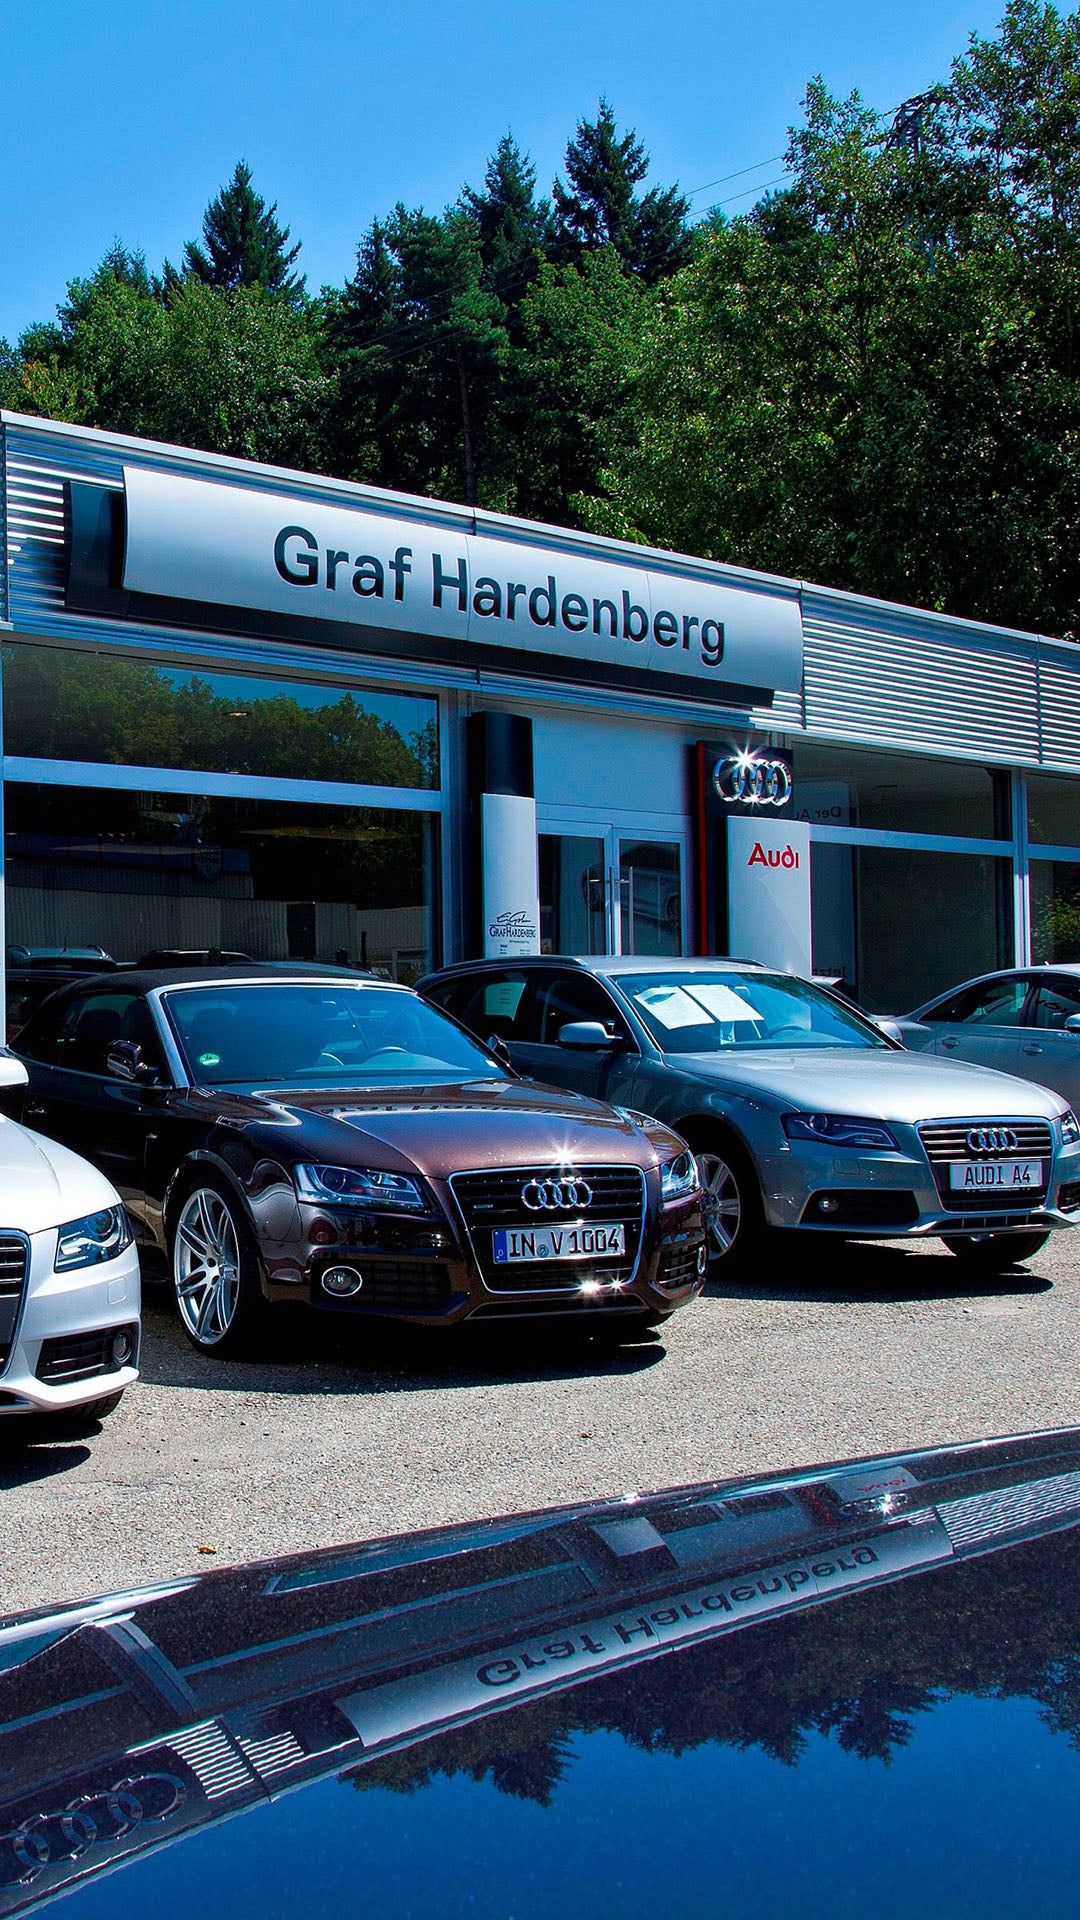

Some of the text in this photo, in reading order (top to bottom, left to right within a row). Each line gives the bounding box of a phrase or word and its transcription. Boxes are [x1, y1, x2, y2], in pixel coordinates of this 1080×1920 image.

[274, 525, 726, 667] Graf Hardenberg
[747, 842, 799, 869] Audi
[964, 1164, 1031, 1185] AUDI A4
[509, 1233, 536, 1257] IN
[569, 1227, 620, 1254] 1004
